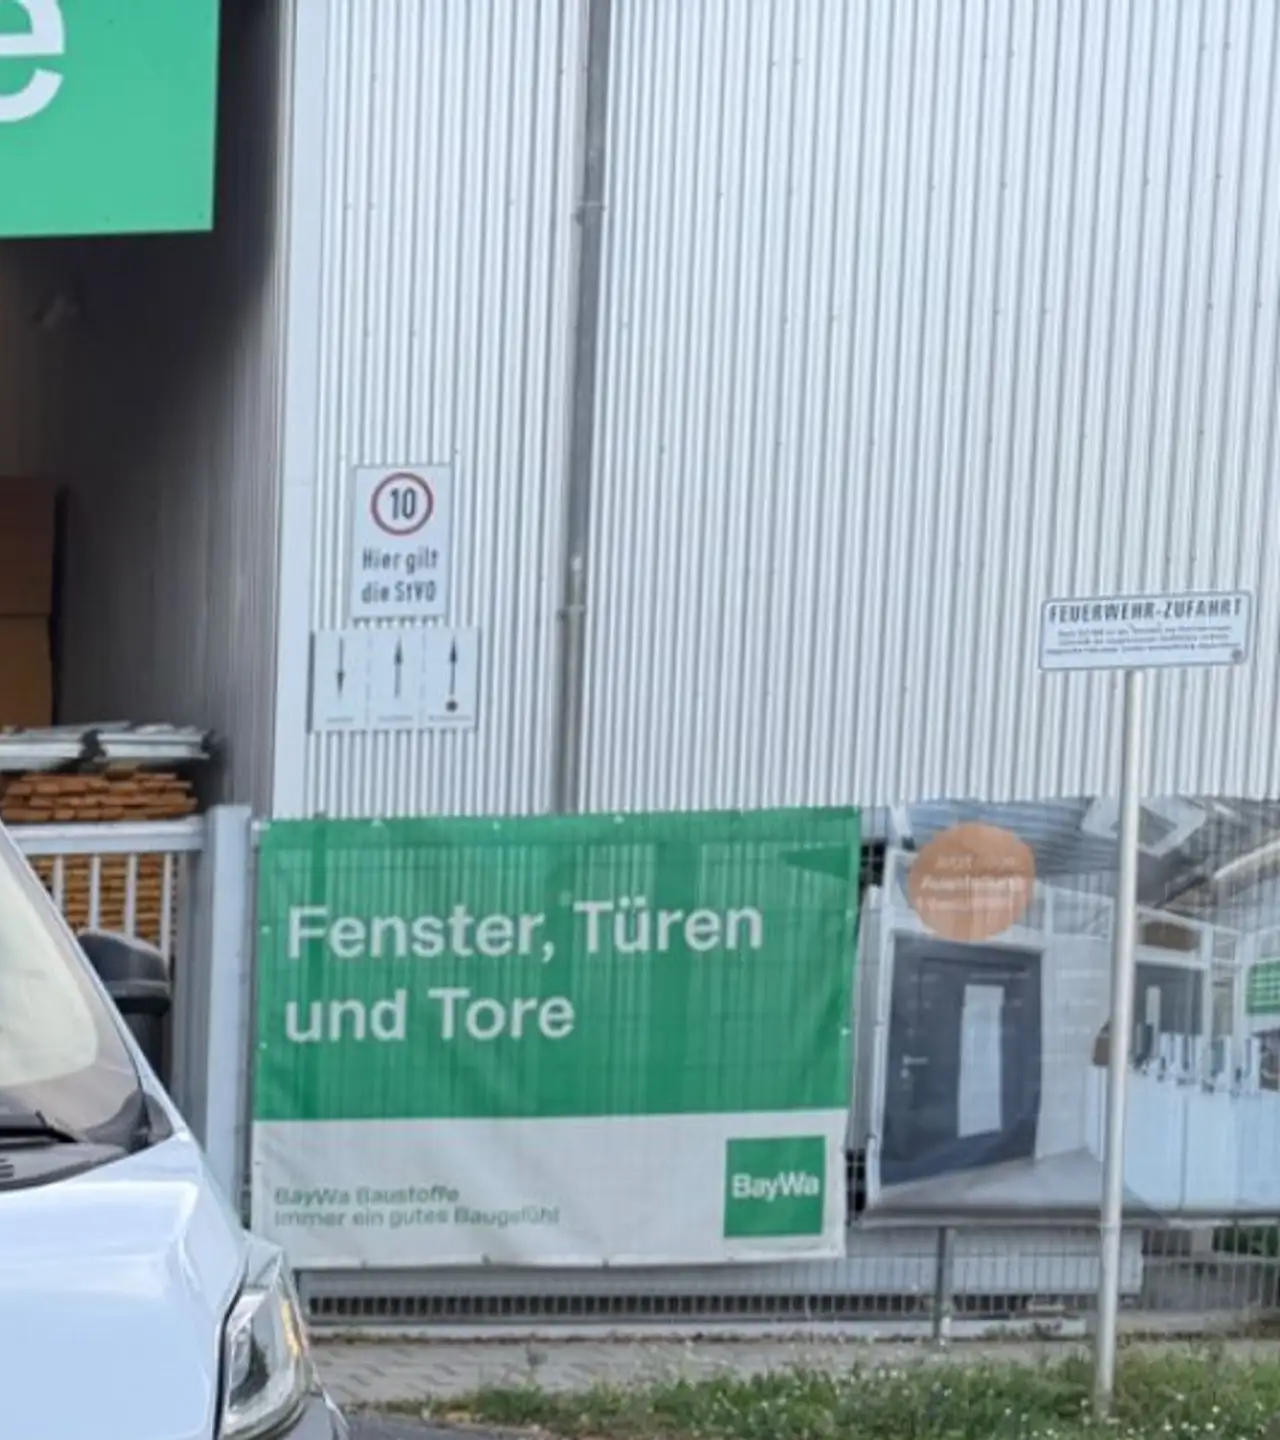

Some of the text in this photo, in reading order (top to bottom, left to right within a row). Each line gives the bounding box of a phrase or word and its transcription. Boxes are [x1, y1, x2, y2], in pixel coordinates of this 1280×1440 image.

[390, 487, 417, 520] 10
[362, 547, 439, 574] Hier gilt
[361, 580, 437, 604] die StVO
[287, 896, 764, 963] Fenster, Türen
[285, 987, 576, 1042] und Tore
[274, 1185, 461, 1207] BayWa Baustoffe
[732, 1171, 820, 1202] BayWa
